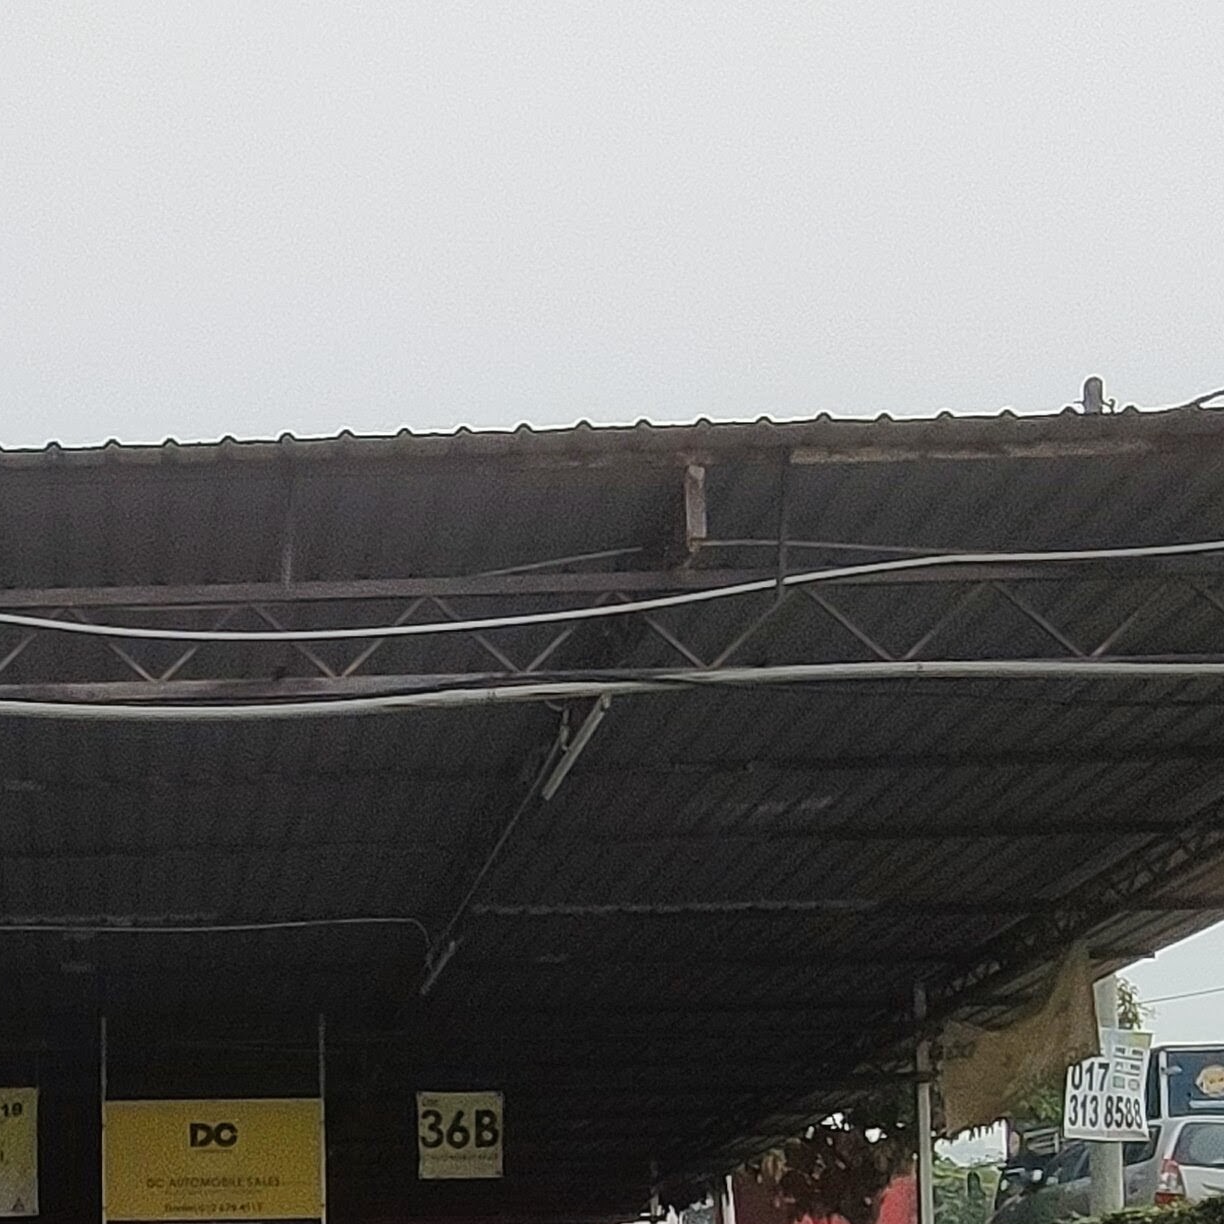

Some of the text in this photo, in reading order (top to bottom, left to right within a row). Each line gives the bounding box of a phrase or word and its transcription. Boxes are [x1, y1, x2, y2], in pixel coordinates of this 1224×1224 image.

[1071, 1061, 1111, 1092] 017
[1068, 1094, 1144, 1129] 313 8588
[189, 1122, 239, 1148] DC
[419, 1108, 500, 1150] 36B
